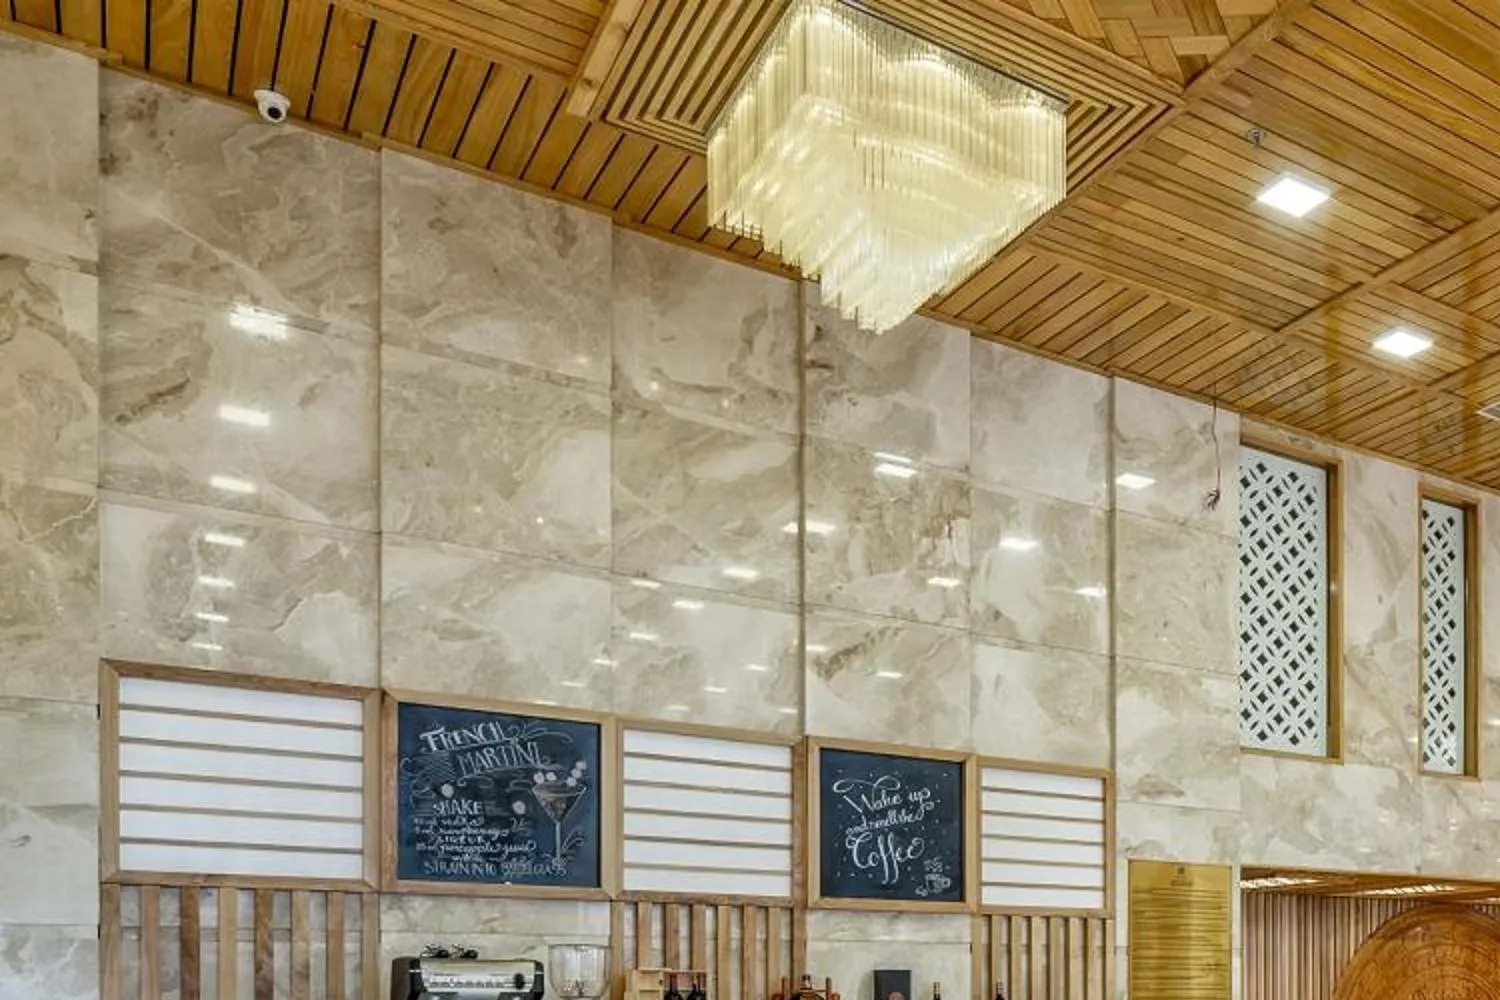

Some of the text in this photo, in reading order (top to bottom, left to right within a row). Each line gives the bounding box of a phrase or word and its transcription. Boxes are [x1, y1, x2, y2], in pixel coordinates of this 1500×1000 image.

[419, 721, 507, 752] FRENCH
[456, 741, 543, 778] MARTINI
[432, 799, 483, 815] SHAKE
[845, 831, 925, 885] Coffee
